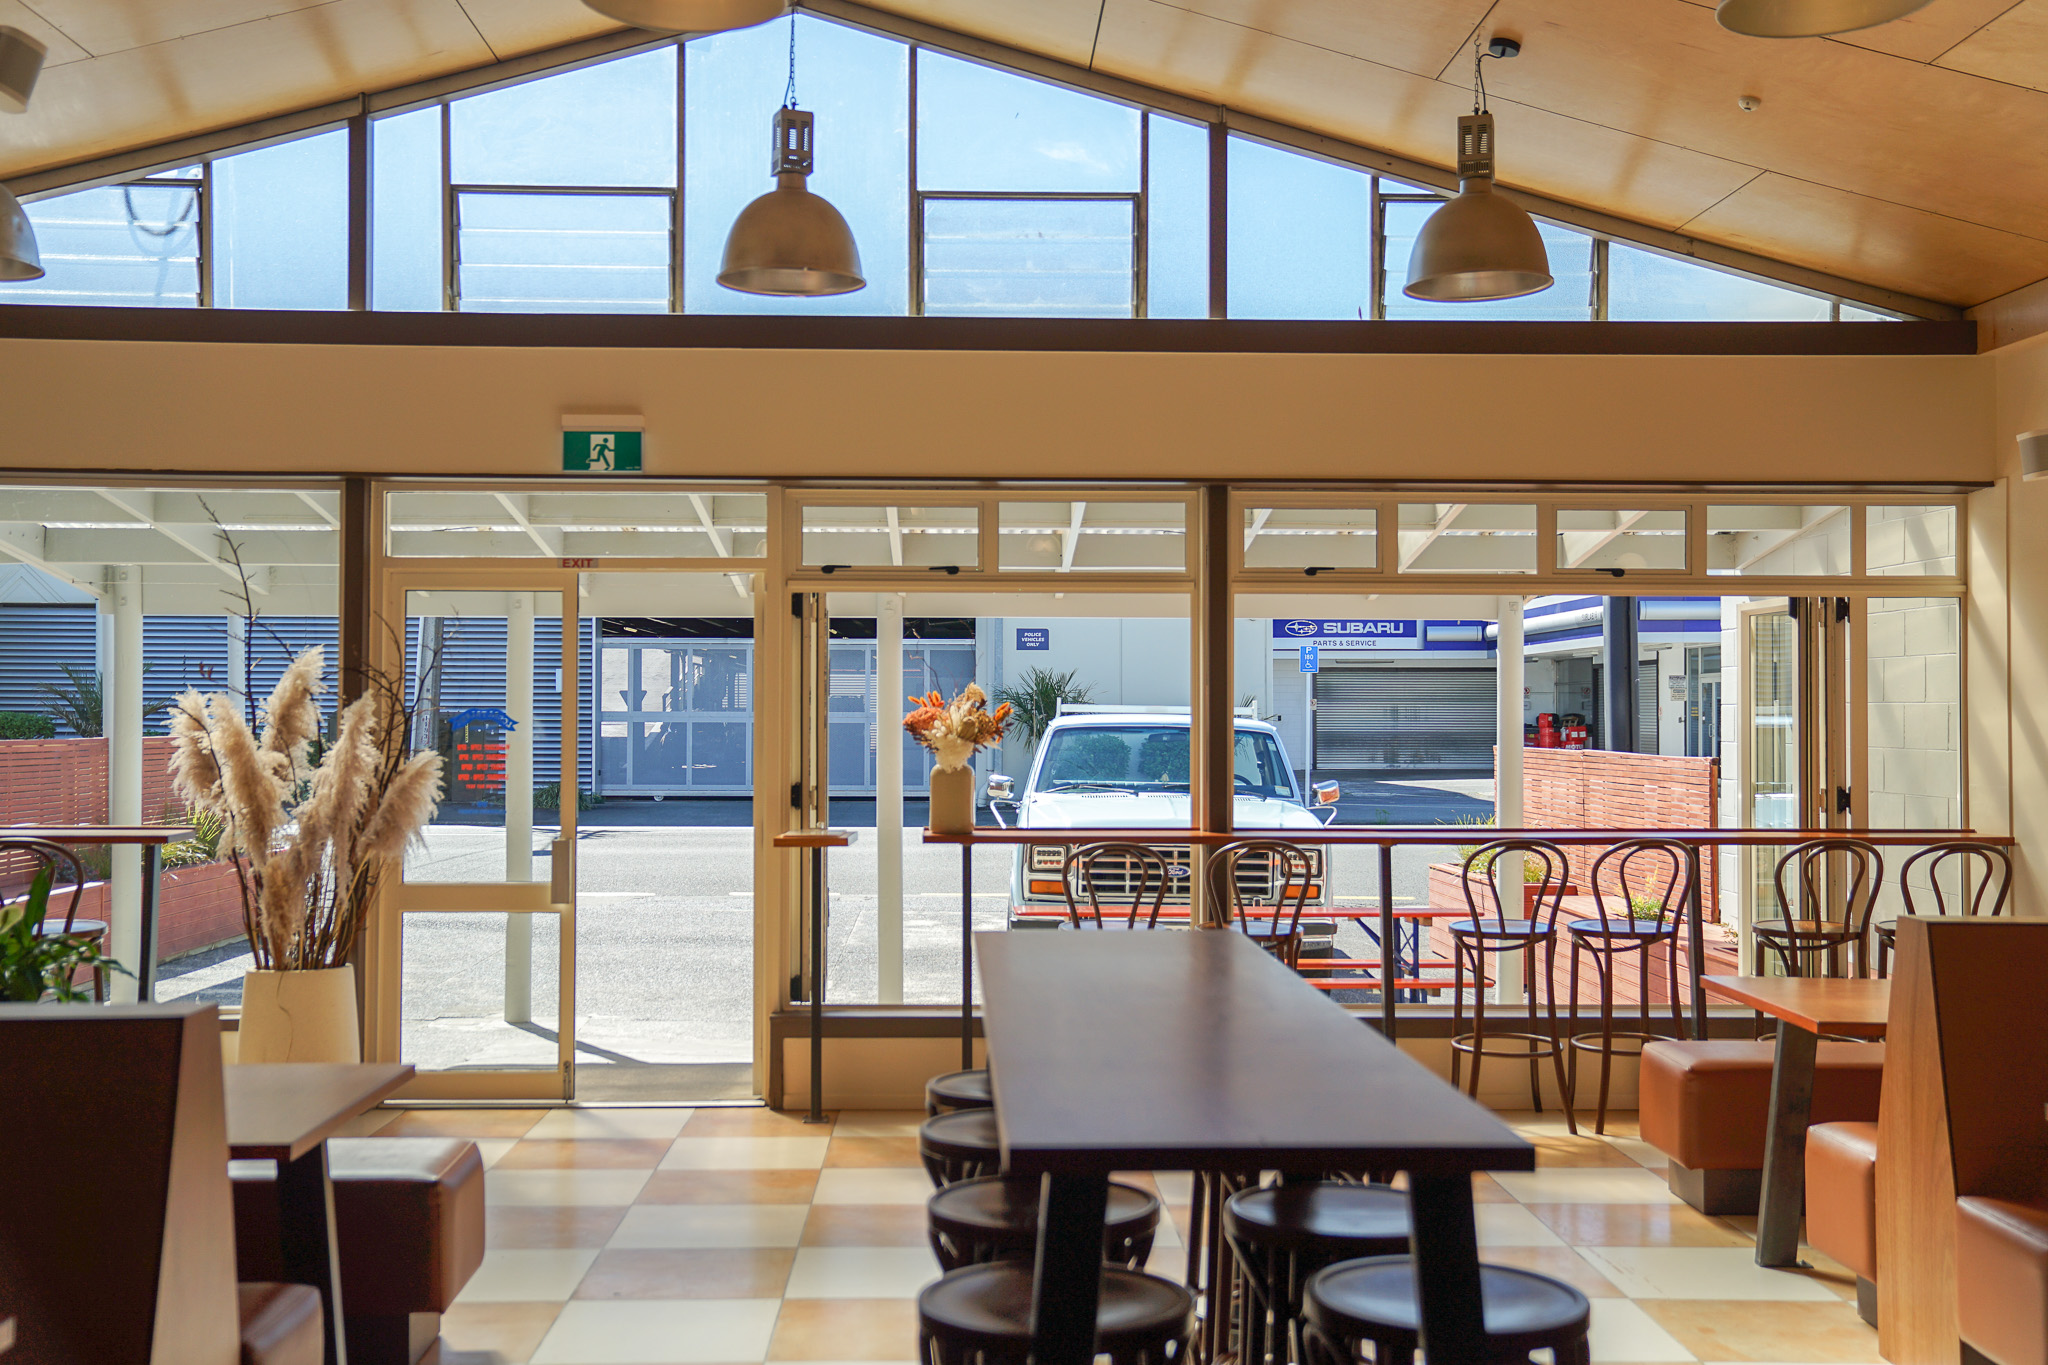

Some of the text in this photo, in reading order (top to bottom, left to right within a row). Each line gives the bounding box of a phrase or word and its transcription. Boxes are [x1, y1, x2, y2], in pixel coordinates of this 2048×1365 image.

[562, 558, 593, 568] EXIT
[1323, 622, 1404, 634] SUBARU
[1305, 646, 1313, 654] P
